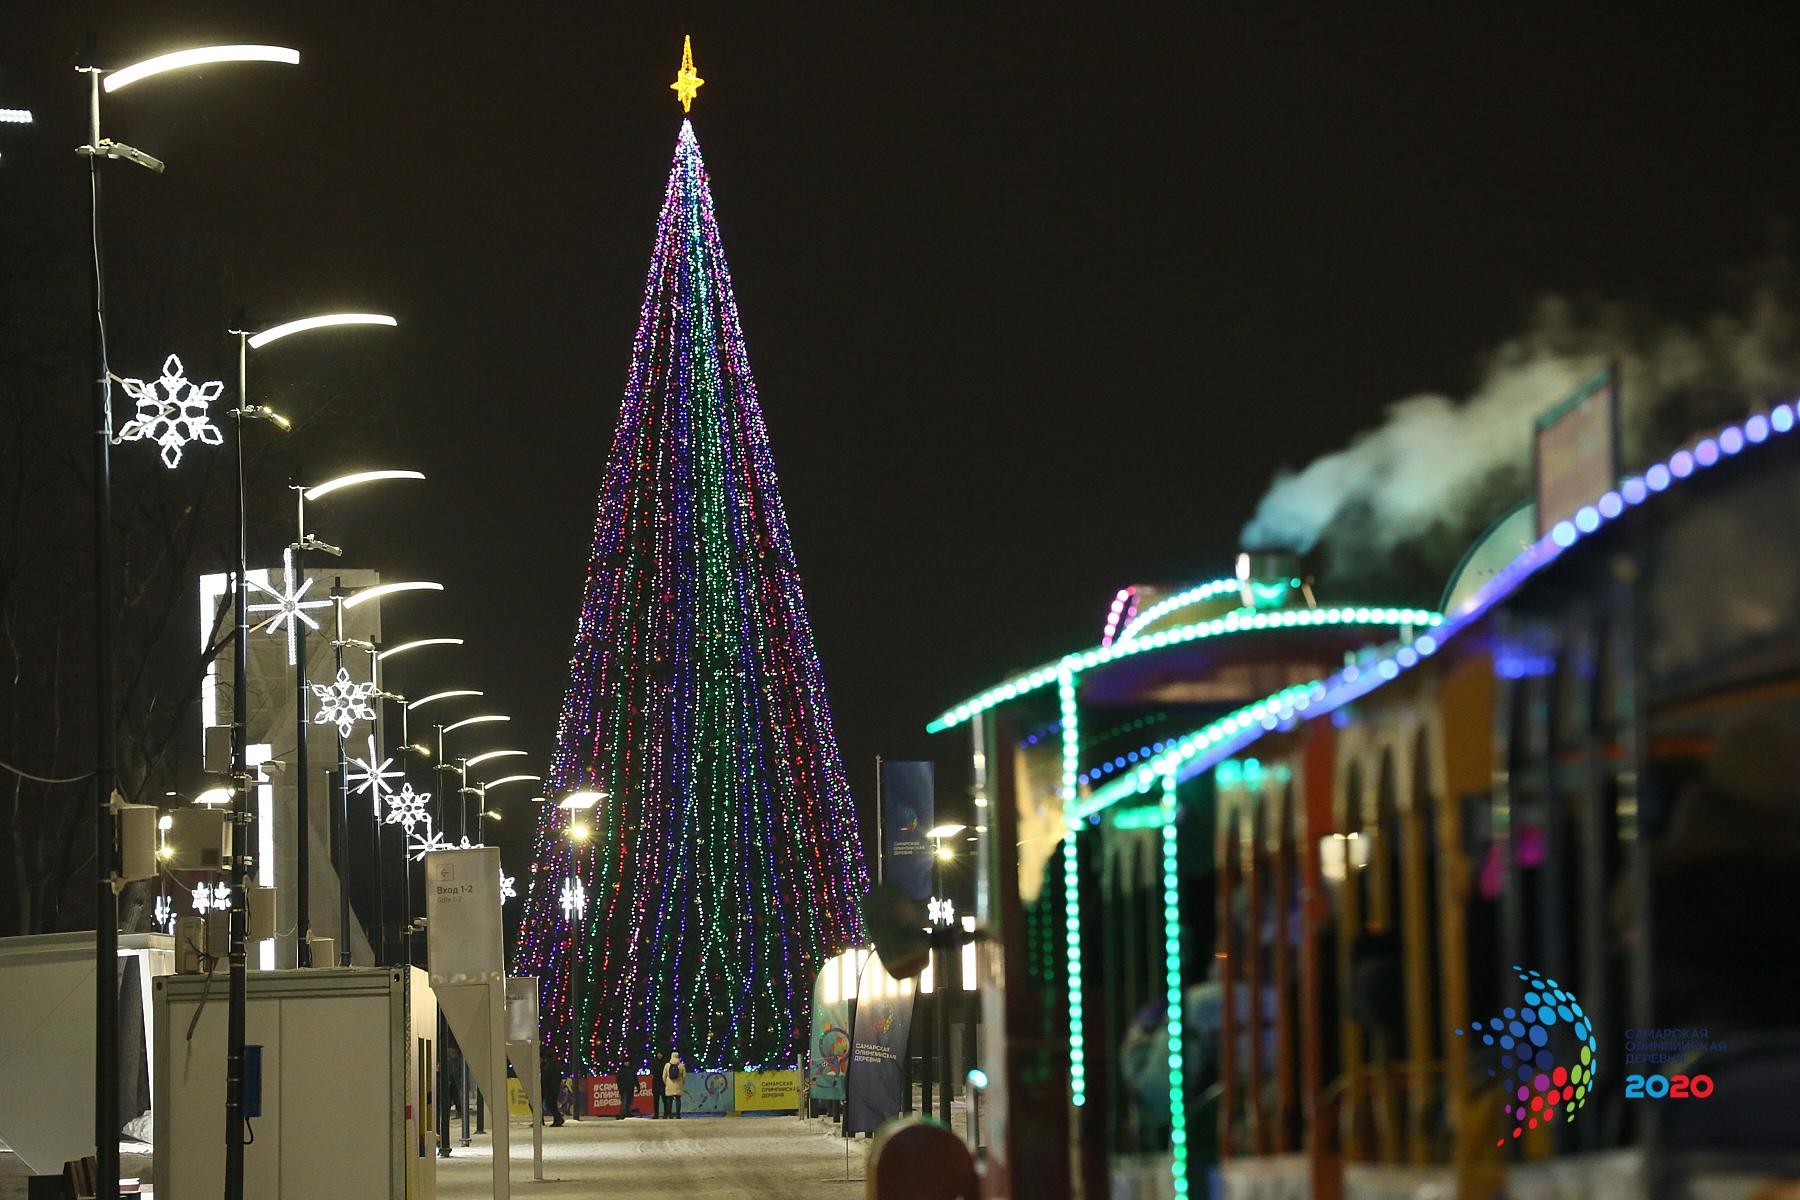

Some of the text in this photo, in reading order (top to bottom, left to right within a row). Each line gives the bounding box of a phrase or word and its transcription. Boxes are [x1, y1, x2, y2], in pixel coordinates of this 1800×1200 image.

[436, 884, 473, 895] Вход 1-2
[855, 1043, 890, 1052] САМАРСКАЯ
[853, 1055, 882, 1063] ДЕРЕВНЯ
